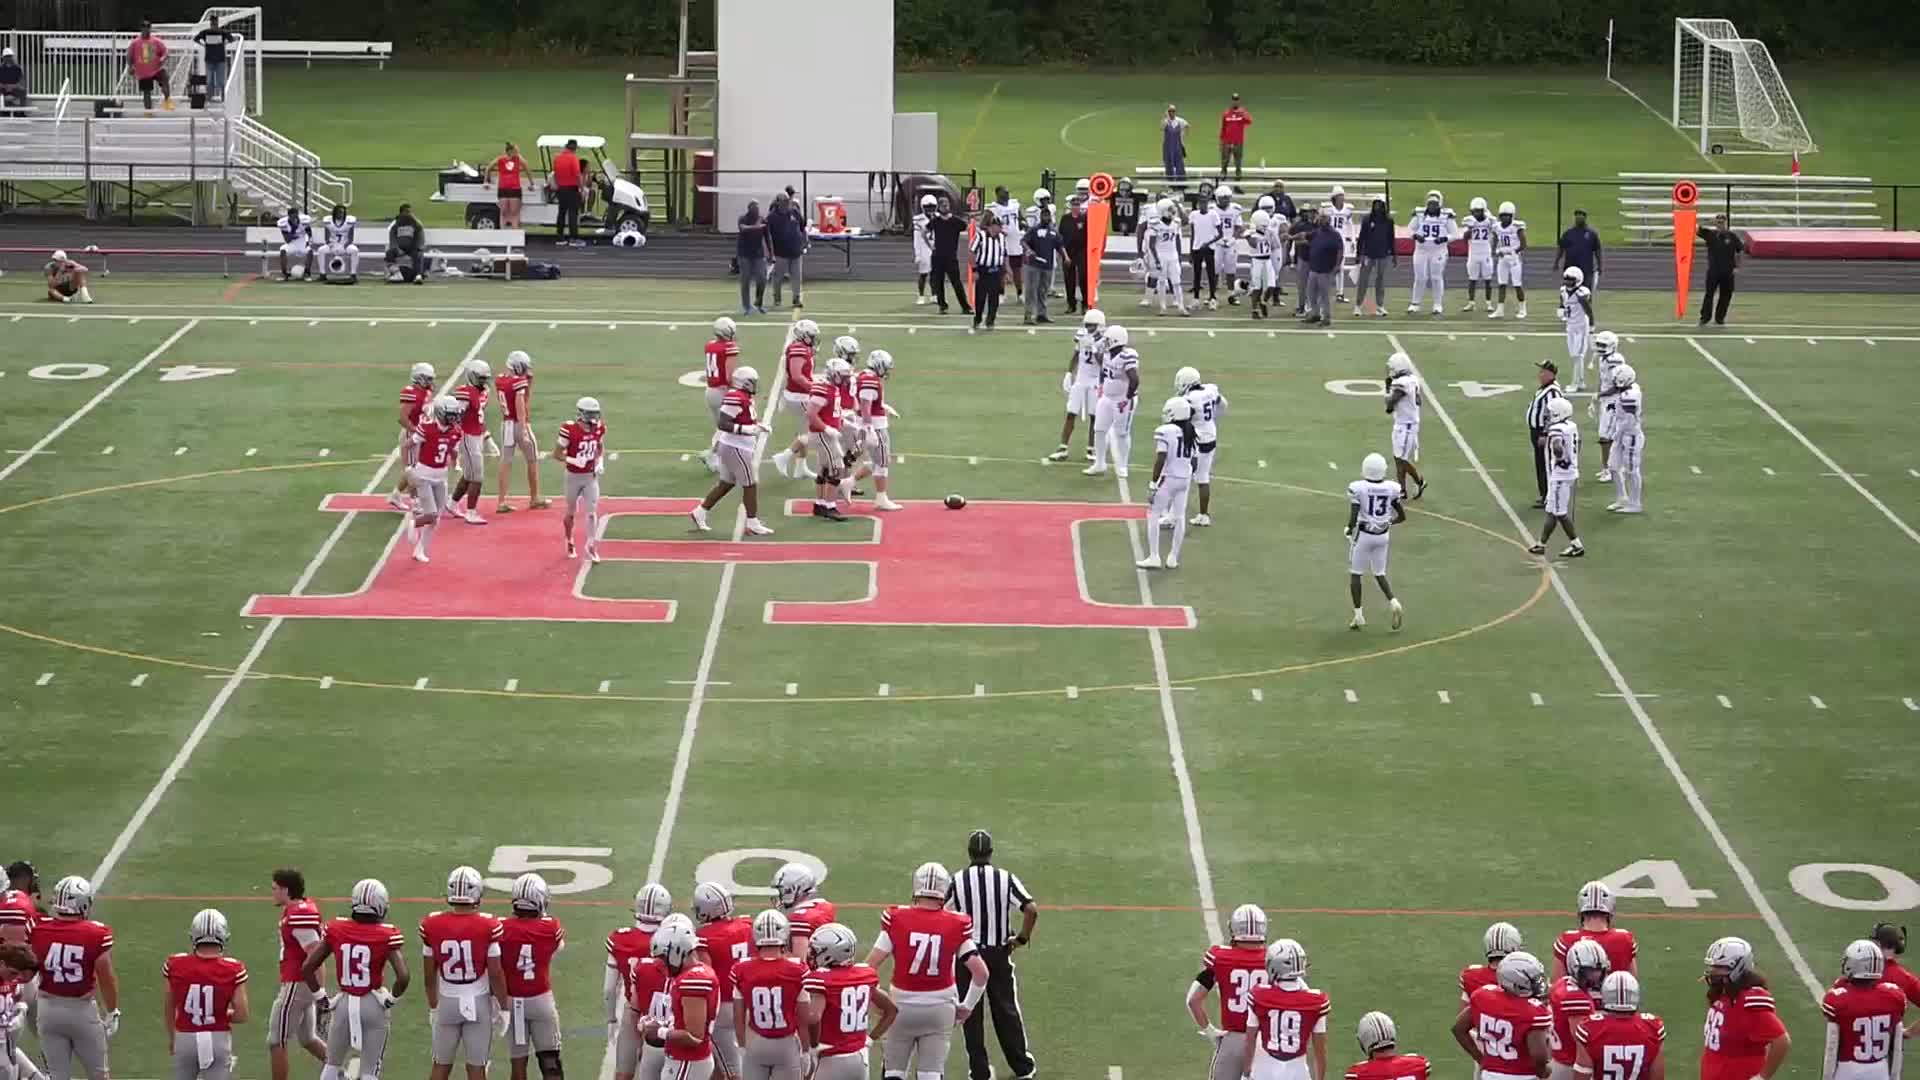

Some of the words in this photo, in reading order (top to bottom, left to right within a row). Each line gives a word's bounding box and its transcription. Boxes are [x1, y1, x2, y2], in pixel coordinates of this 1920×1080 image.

[966, 189, 980, 211] 4
[1423, 224, 1440, 238] 99
[1472, 228, 1489, 240] 22
[434, 443, 448, 463] 3
[1368, 495, 1389, 517] 13
[44, 942, 84, 983] 45
[340, 944, 371, 987] 13
[440, 940, 476, 981] 21
[516, 943, 536, 980] 4
[909, 932, 942, 976] 71
[184, 983, 216, 1025] 41
[752, 986, 787, 1030] 81
[840, 984, 871, 1033] 82
[1267, 1009, 1302, 1053] 18
[1479, 1013, 1518, 1061] 52
[1853, 1014, 1891, 1061] 35
[1603, 1044, 1645, 1080] 57
